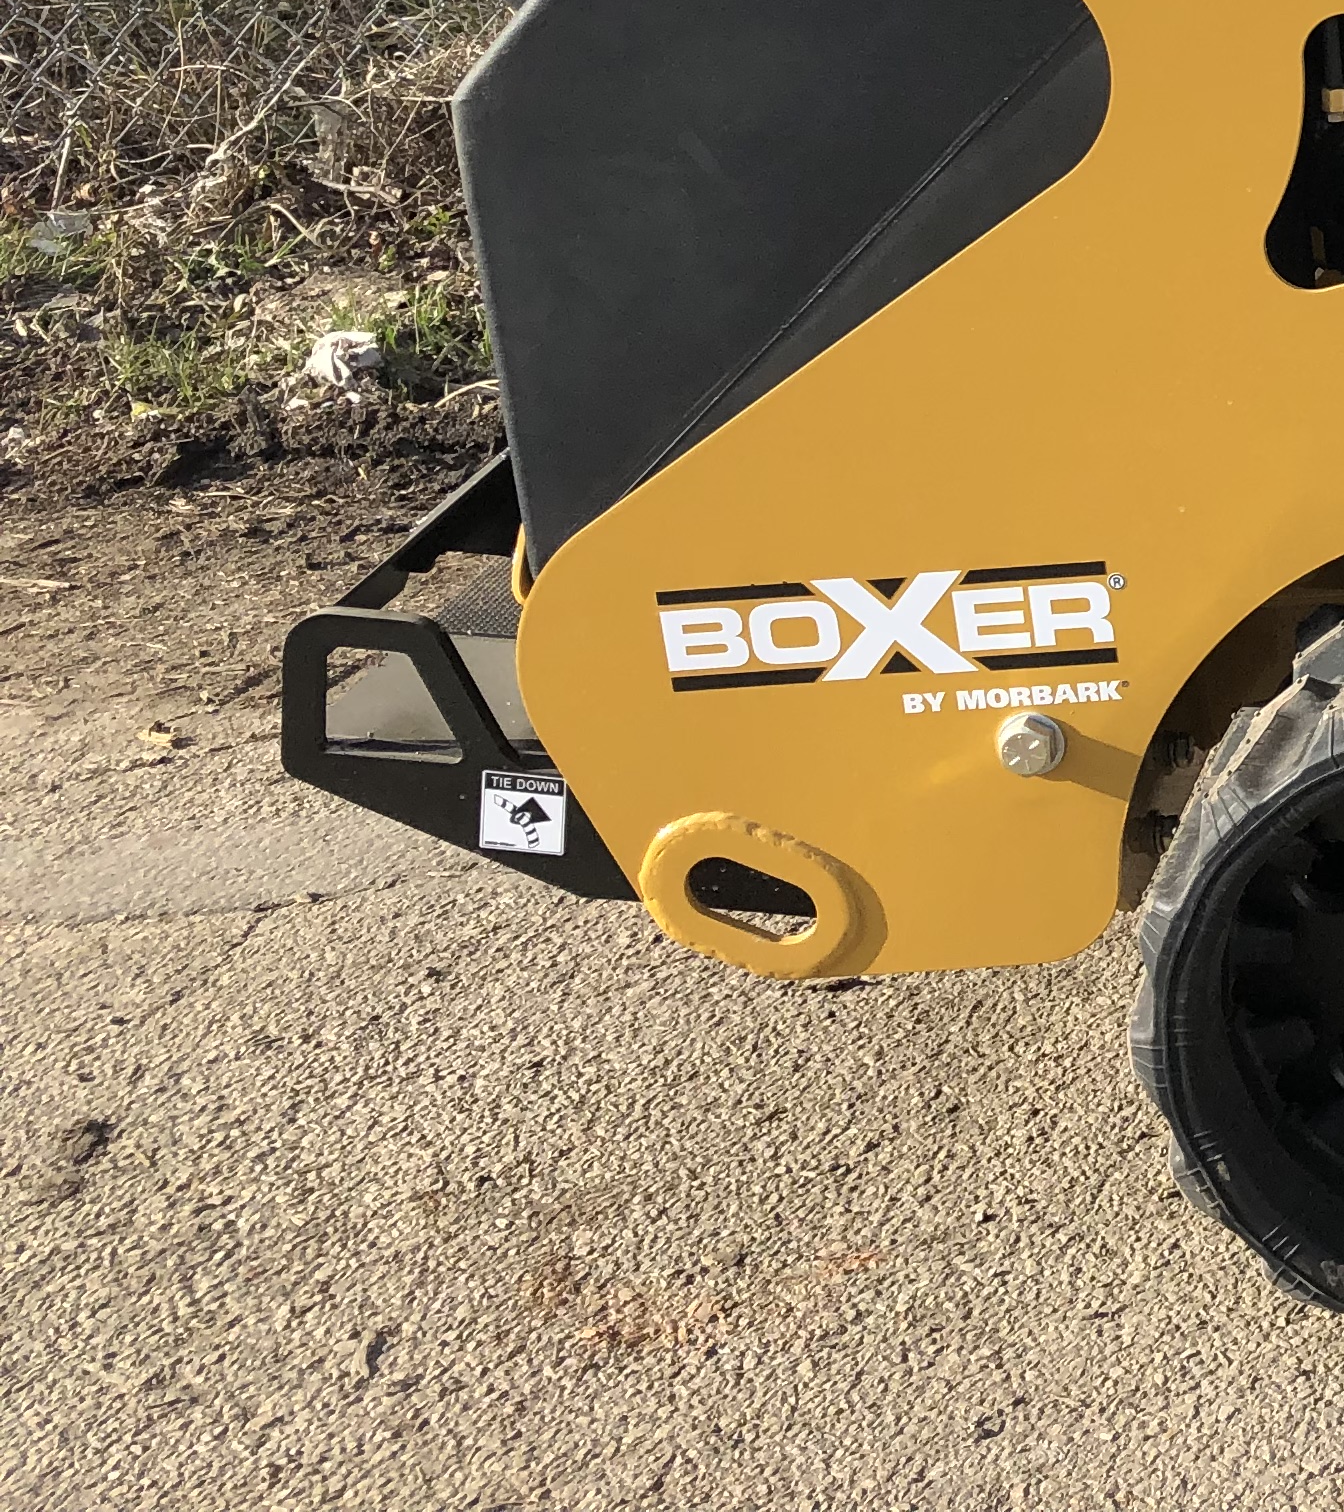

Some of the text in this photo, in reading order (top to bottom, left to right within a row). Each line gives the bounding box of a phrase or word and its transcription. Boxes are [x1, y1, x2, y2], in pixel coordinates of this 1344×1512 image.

[659, 569, 1115, 682] BOXER
[902, 681, 1122, 714] BY MORBARK
[491, 776, 559, 793] TIE DOWN
